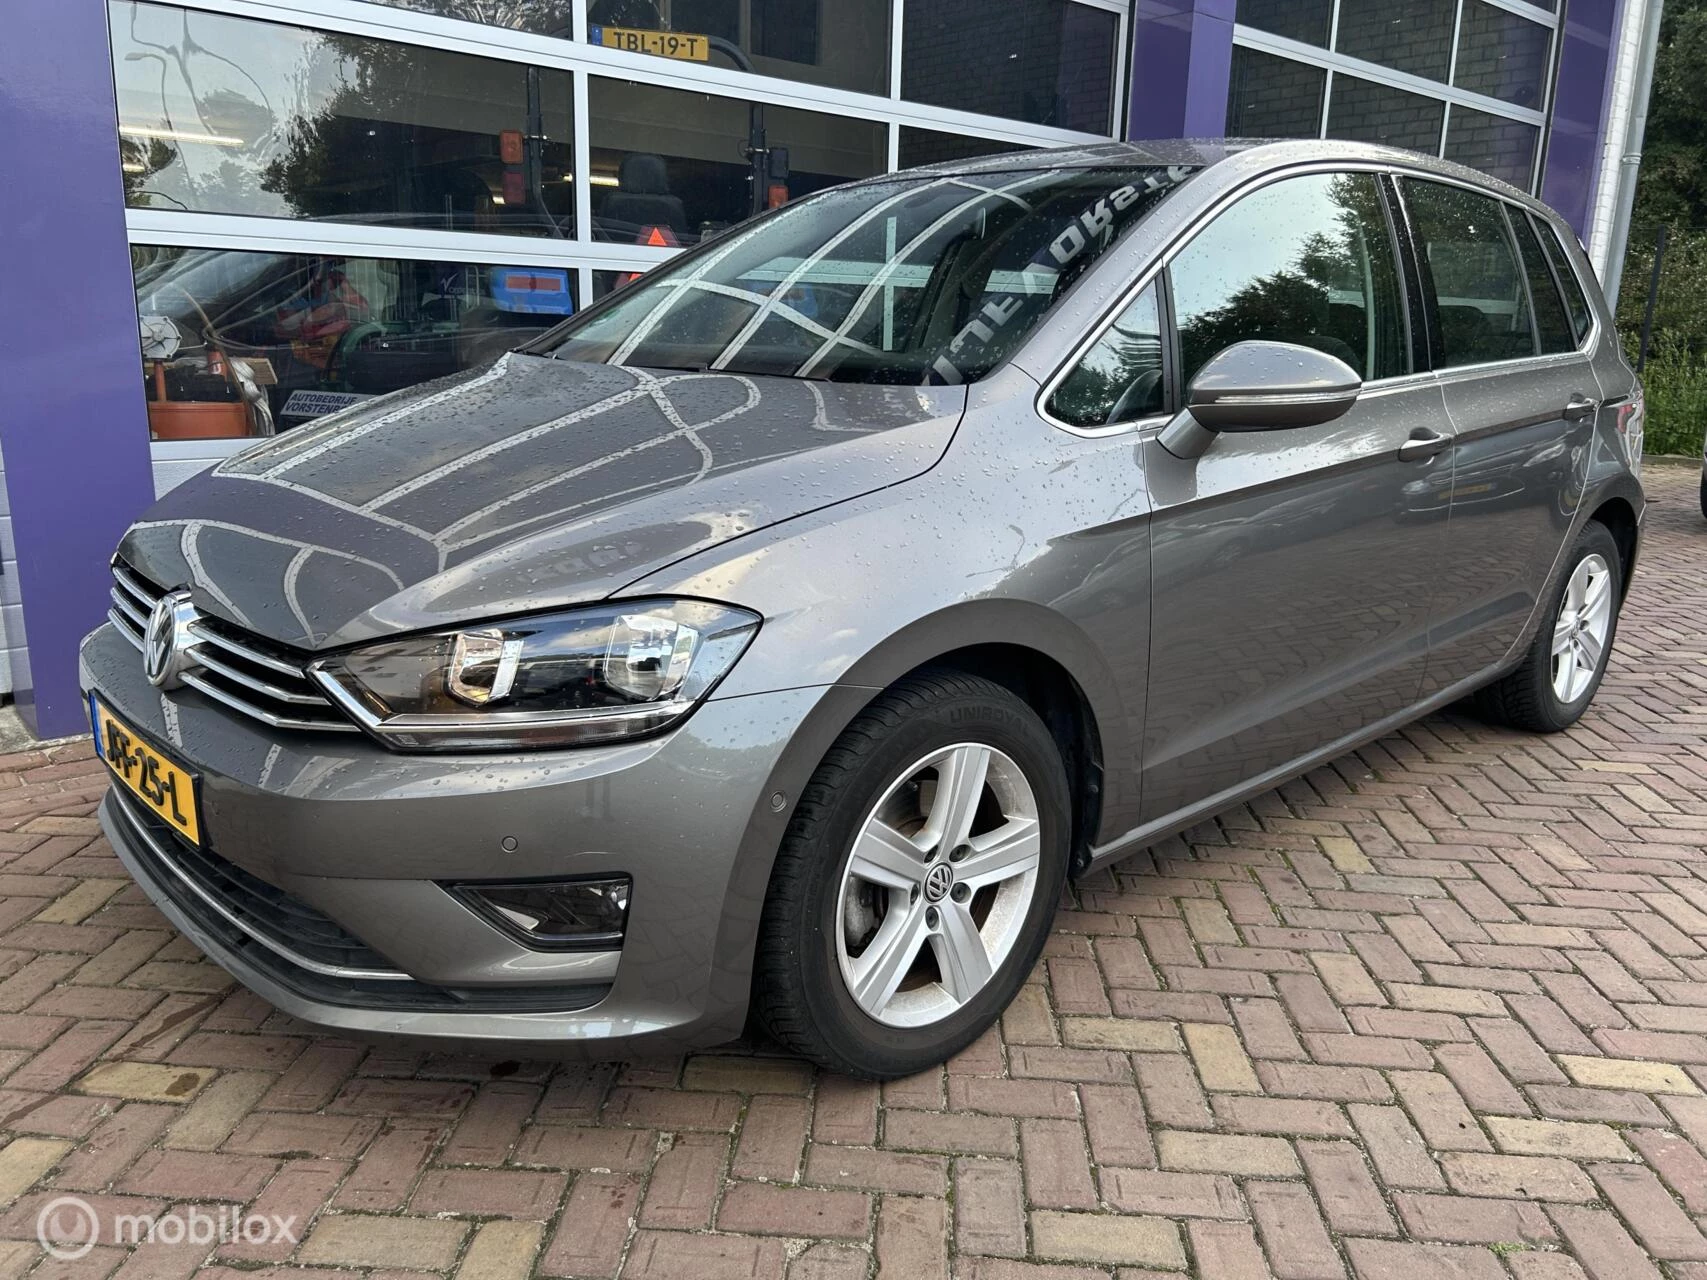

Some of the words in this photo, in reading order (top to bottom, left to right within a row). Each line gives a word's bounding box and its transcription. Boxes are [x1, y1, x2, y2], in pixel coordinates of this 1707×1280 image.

[613, 31, 698, 57] TBL-19-T
[290, 393, 358, 405] AUTOBEDRIJF
[285, 402, 347, 414] VORSTENB
